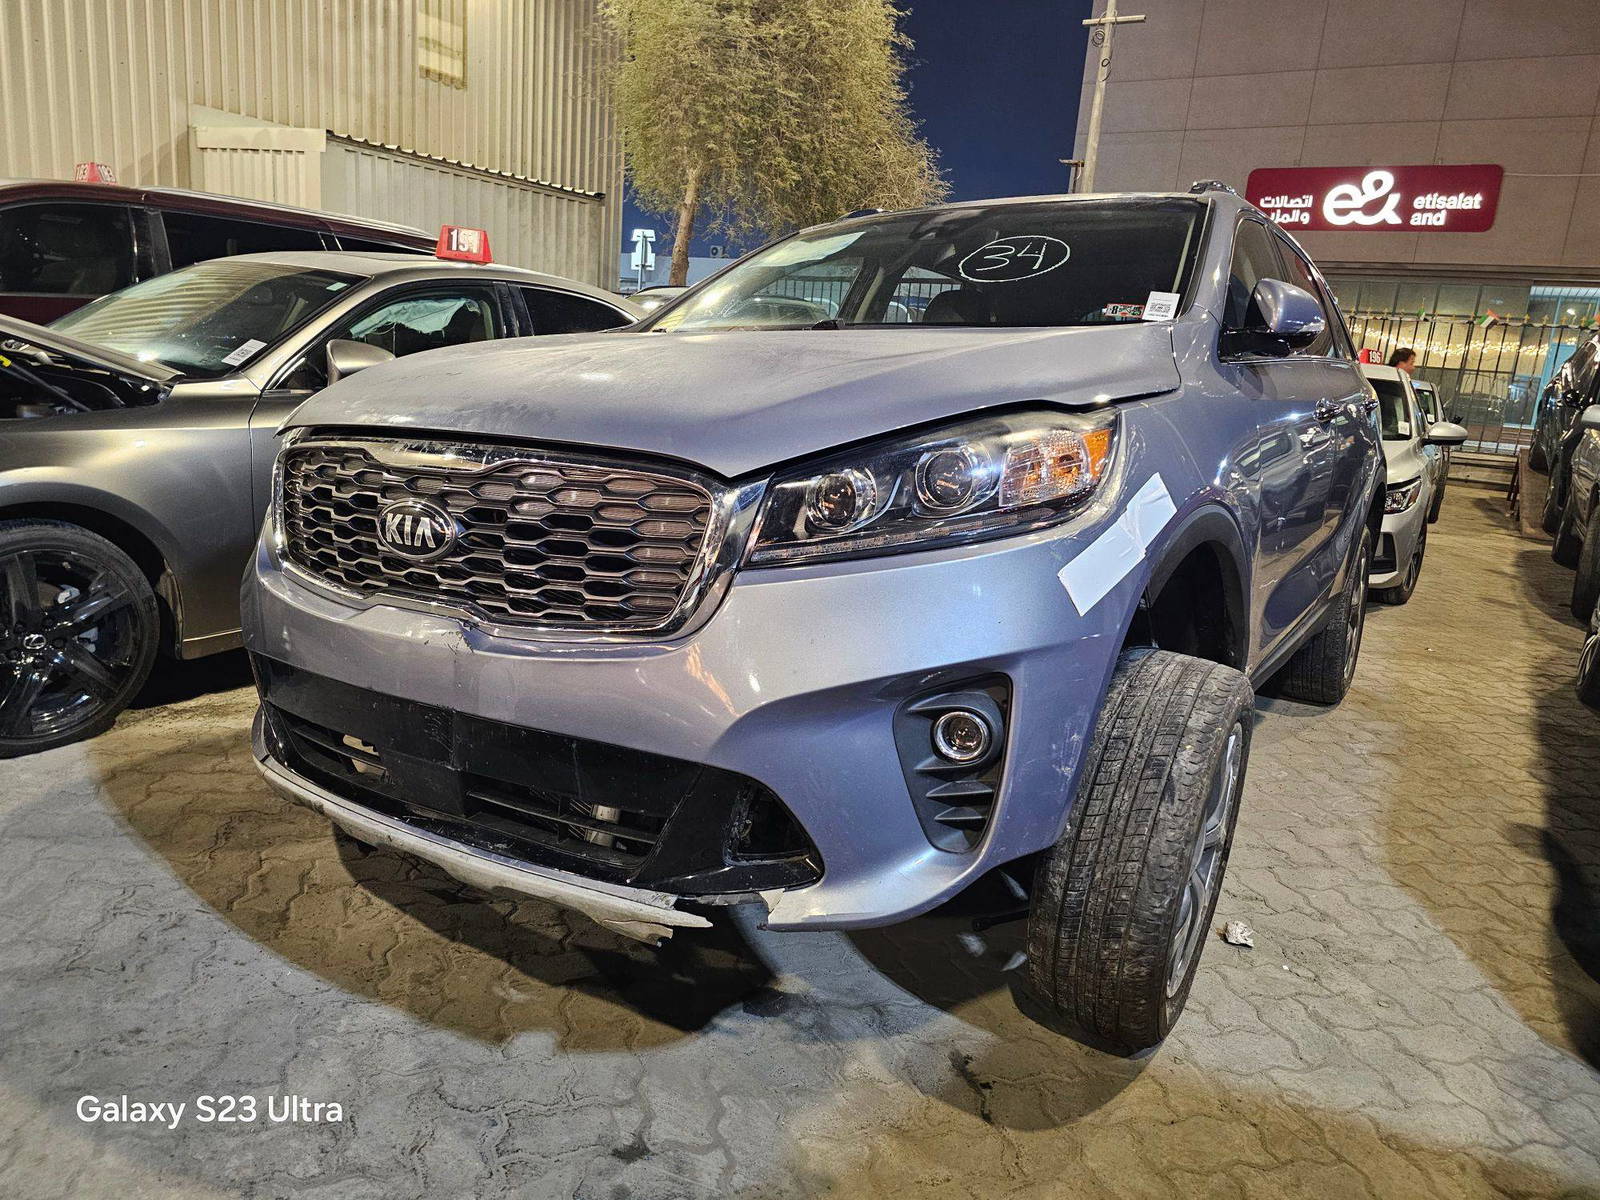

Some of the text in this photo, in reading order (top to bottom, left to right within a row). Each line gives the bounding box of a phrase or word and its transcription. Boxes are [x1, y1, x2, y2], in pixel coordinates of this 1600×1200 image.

[1259, 194, 1313, 208] اتصالات
[1322, 170, 1402, 226] e&
[1413, 192, 1482, 210] etisalat
[1409, 209, 1446, 226] and
[975, 242, 1047, 271] 34
[1369, 350, 1381, 364] 196
[385, 512, 436, 548] KIA
